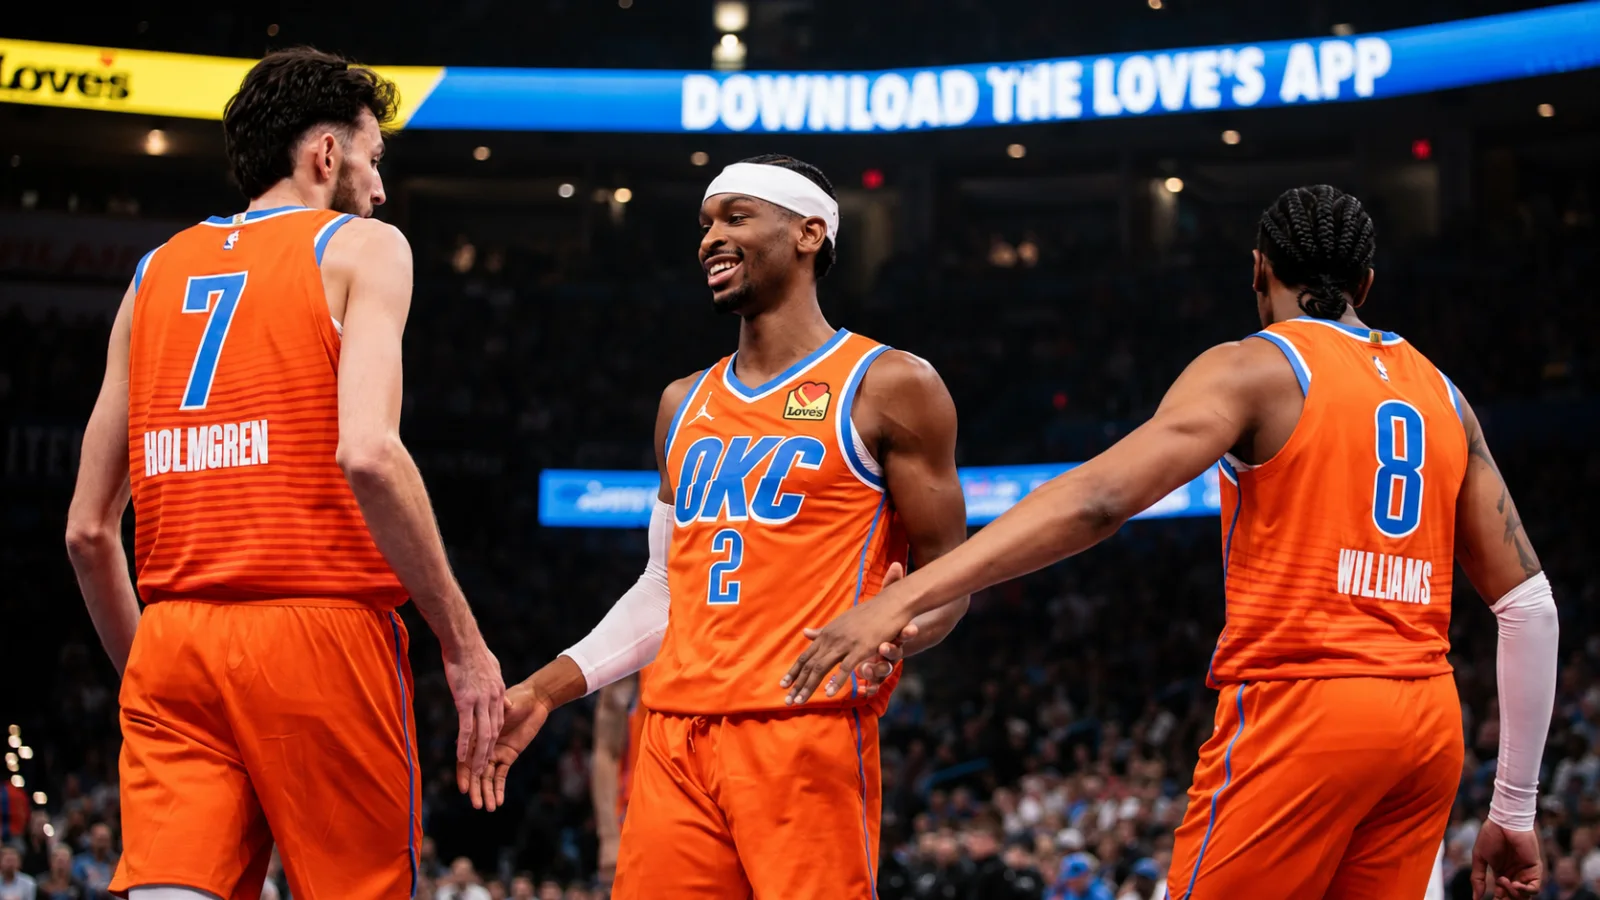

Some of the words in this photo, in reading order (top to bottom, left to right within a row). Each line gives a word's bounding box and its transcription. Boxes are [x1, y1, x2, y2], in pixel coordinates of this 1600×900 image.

[681, 70, 979, 131] DOWNLOAD
[986, 59, 1083, 123] THE
[1093, 46, 1266, 116] LOVE'S
[1279, 36, 1392, 103] APP
[178, 270, 249, 411] 7
[143, 419, 269, 477] HOLMGREN
[786, 406, 824, 417] Love's
[674, 435, 826, 528] OKC
[1372, 398, 1426, 538] 8
[706, 528, 744, 606] 2
[1337, 548, 1433, 605] WILLIAMS
